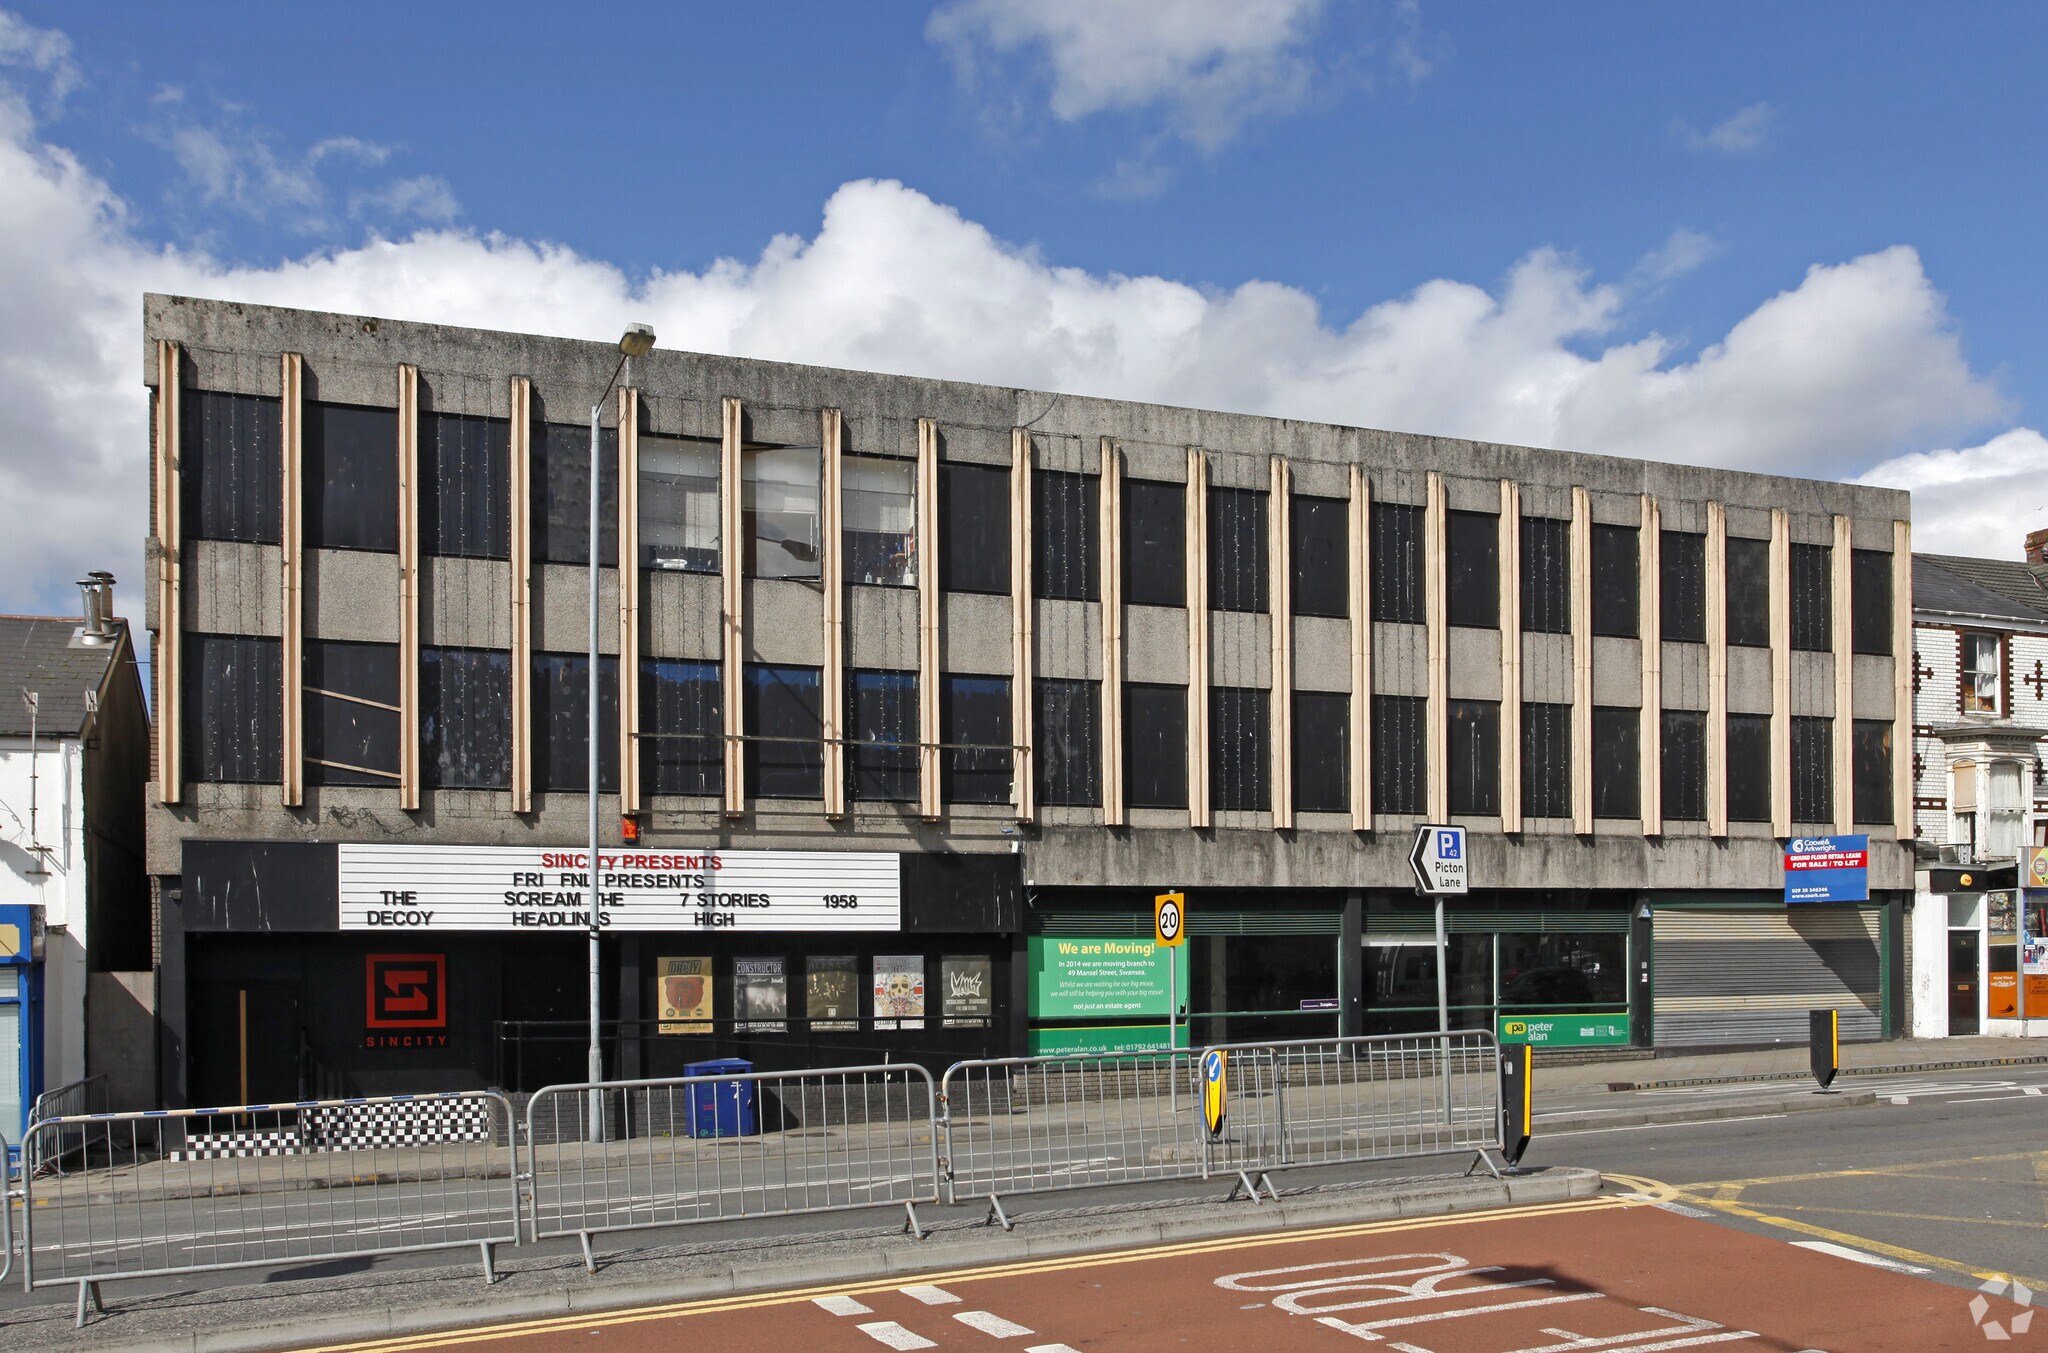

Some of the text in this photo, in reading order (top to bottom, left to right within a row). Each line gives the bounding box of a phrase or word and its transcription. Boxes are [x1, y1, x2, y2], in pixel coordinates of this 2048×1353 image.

[1440, 833, 1454, 857] P
[1449, 849, 1458, 857] 42
[542, 853, 722, 870] SINCTY PRESENTS
[1435, 862, 1464, 873] Picton
[513, 872, 544, 887] FRI
[605, 873, 705, 889] PRESENTS
[1440, 876, 1461, 887] Lane
[380, 891, 417, 906] THE
[504, 891, 625, 906] SCREAM HE
[680, 893, 770, 907] 7 STORIES
[822, 895, 858, 909] 1958
[367, 911, 434, 926] DECOY
[513, 912, 611, 927] HEADLINS
[694, 912, 735, 927] HIGH
[1161, 911, 1177, 929] 20
[1058, 942, 1155, 957] We are Moving!
[736, 963, 782, 974] CONSTRUCTOR
[1113, 981, 1121, 989] for
[1085, 990, 1104, 998] helping
[1084, 1002, 1096, 1011] just
[1124, 1003, 1141, 1011] agent
[1512, 1022, 1553, 1034] pa peter
[366, 1036, 446, 1047] SINCITY
[1528, 1032, 1548, 1041] alan
[1037, 1044, 1108, 1055] www.peteralan.co.uk
[1147, 1042, 1171, 1050] 641481
[1214, 1252, 1828, 1353] ETRO
